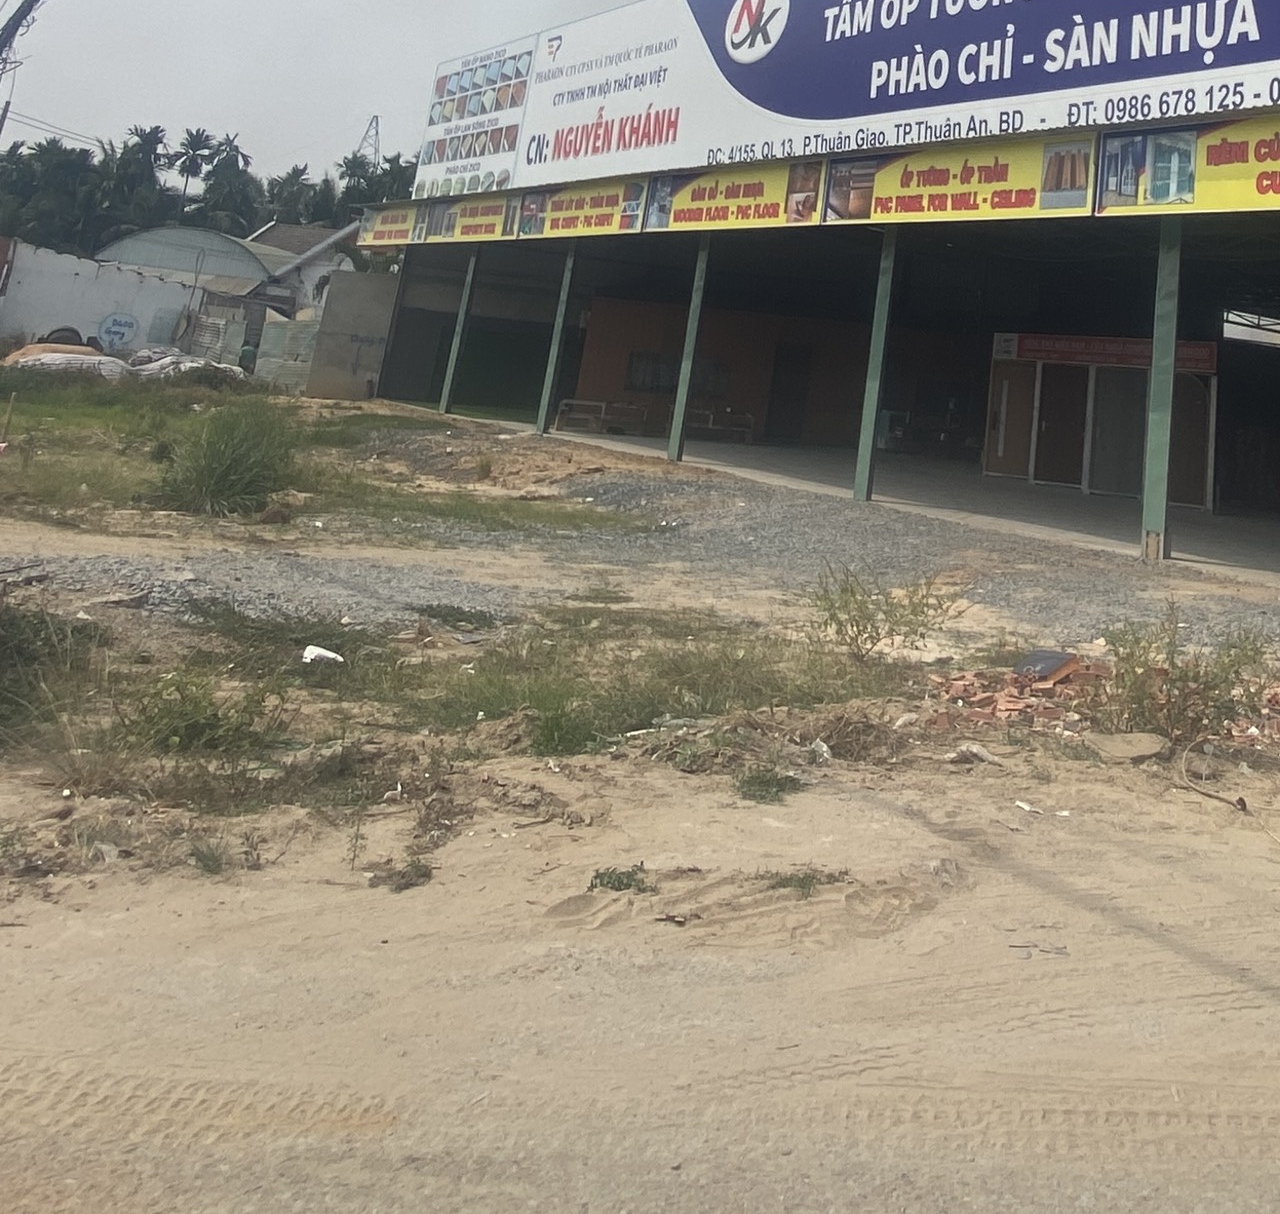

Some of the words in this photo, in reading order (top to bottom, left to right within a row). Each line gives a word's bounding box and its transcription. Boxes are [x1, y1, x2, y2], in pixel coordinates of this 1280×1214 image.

[870, 44, 949, 99] PHÀO
[958, 23, 1015, 85] CHỈ
[1044, 14, 1118, 73] SÀN
[526, 133, 549, 165] CN:
[551, 105, 615, 162] NGUYỄN
[616, 102, 680, 152] KHÁNH
[761, 141, 776, 159] QL
[999, 110, 1023, 133] BD
[1067, 101, 1096, 126] ĐT:
[1104, 93, 1151, 122] 0986
[1158, 88, 1196, 117] 678
[1205, 82, 1245, 111] 125
[1206, 138, 1249, 166] RÈM
[950, 191, 979, 211] WALL
